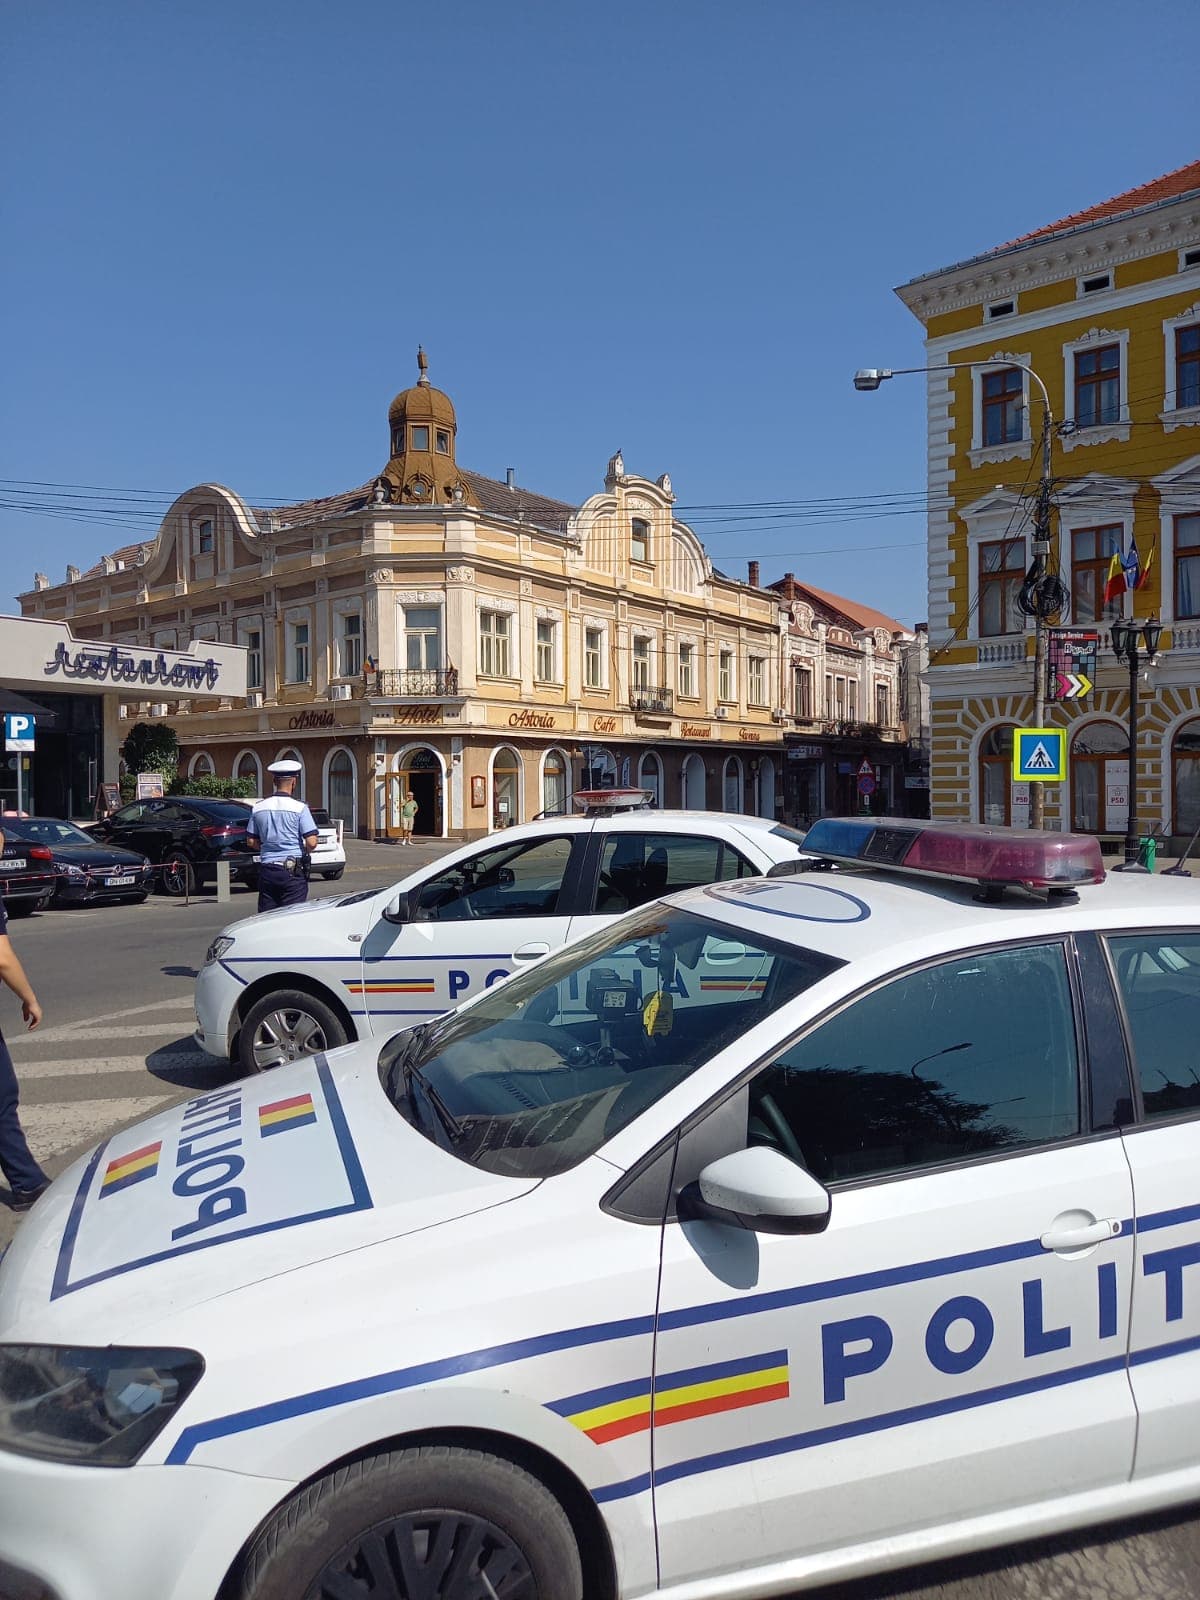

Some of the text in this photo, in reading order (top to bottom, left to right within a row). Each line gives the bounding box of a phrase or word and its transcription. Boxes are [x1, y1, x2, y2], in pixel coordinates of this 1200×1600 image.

[288, 709, 336, 730] Astoria
[394, 704, 441, 724] Hotel
[508, 709, 556, 729] Astoria
[593, 716, 617, 732] Caffe
[10, 716, 29, 738] P
